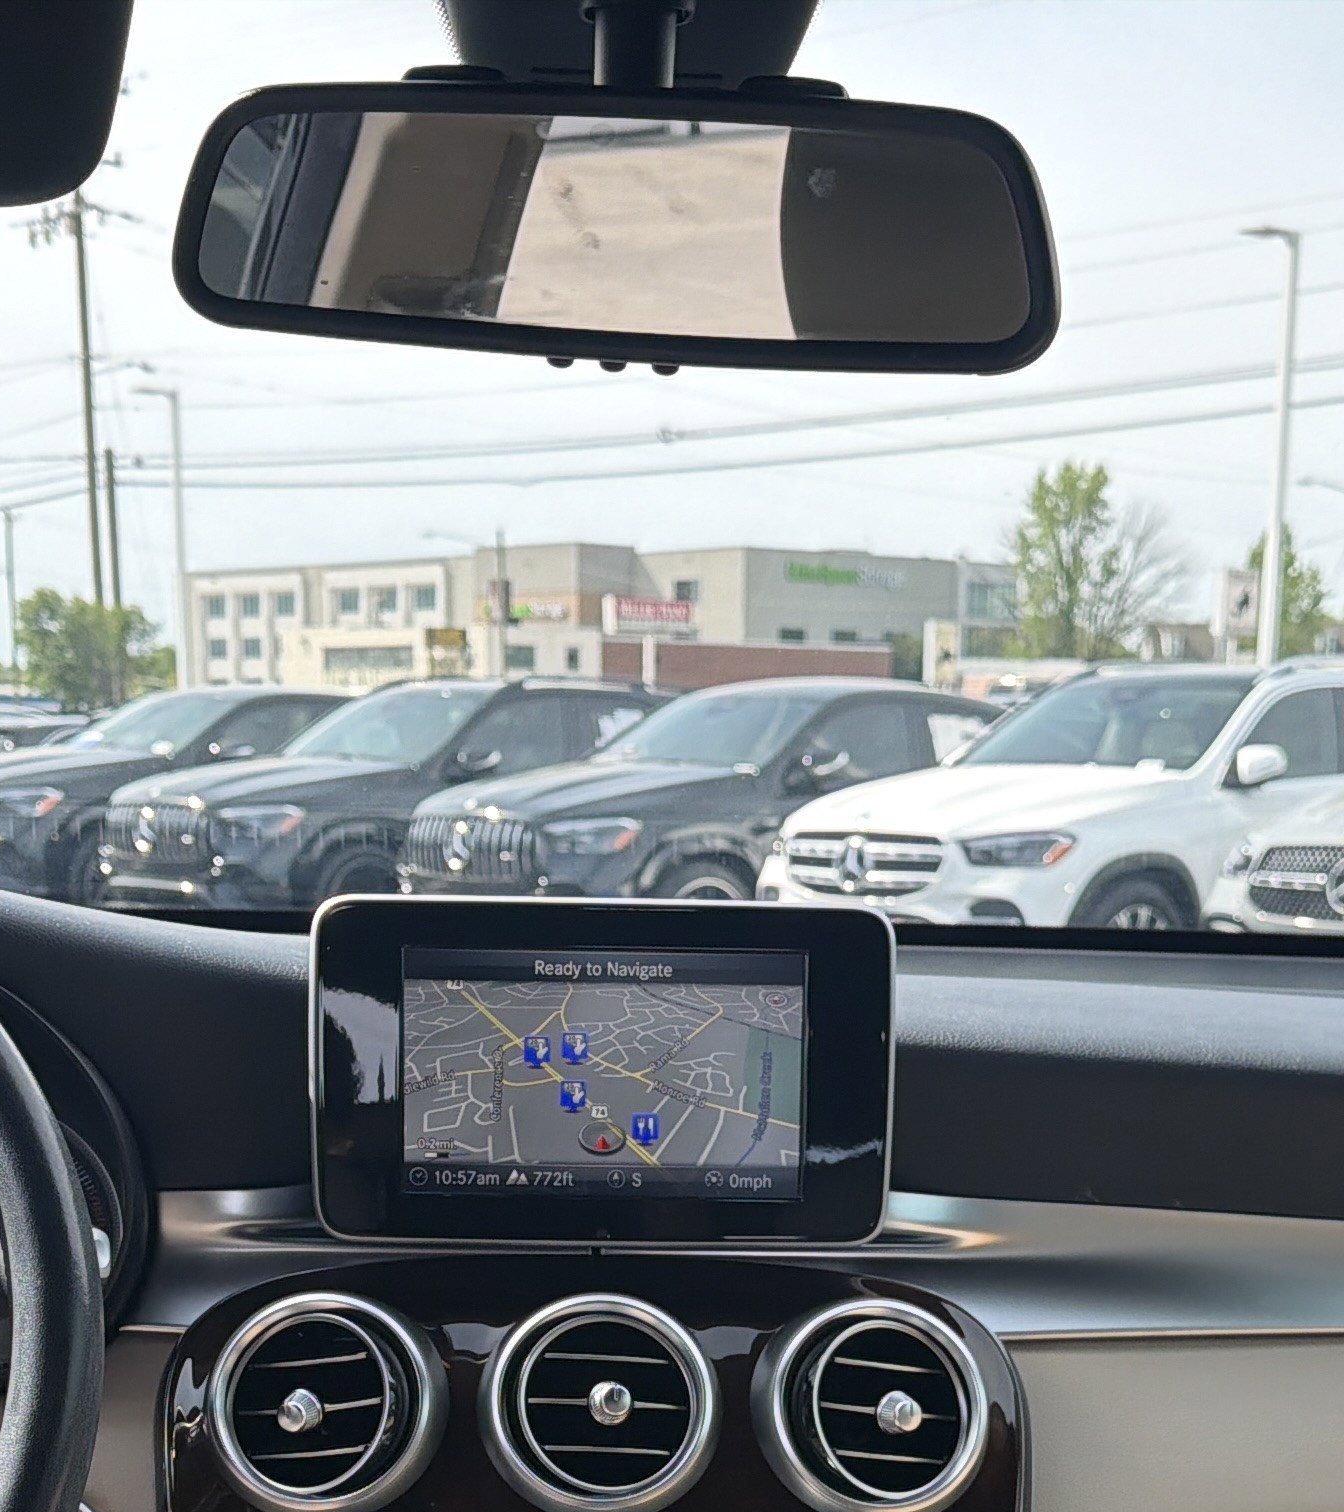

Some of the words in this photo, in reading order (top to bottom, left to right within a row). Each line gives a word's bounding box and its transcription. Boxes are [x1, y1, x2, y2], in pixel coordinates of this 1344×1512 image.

[534, 959, 582, 978] Ready
[587, 962, 601, 976] to
[607, 961, 673, 979] Navigate
[650, 1049, 676, 1072] Rama
[673, 1037, 690, 1055] Rd
[434, 1171, 500, 1186] 10:57am
[533, 1171, 575, 1187] 772ft
[632, 1173, 642, 1188] S
[729, 1174, 772, 1191] 0mph
